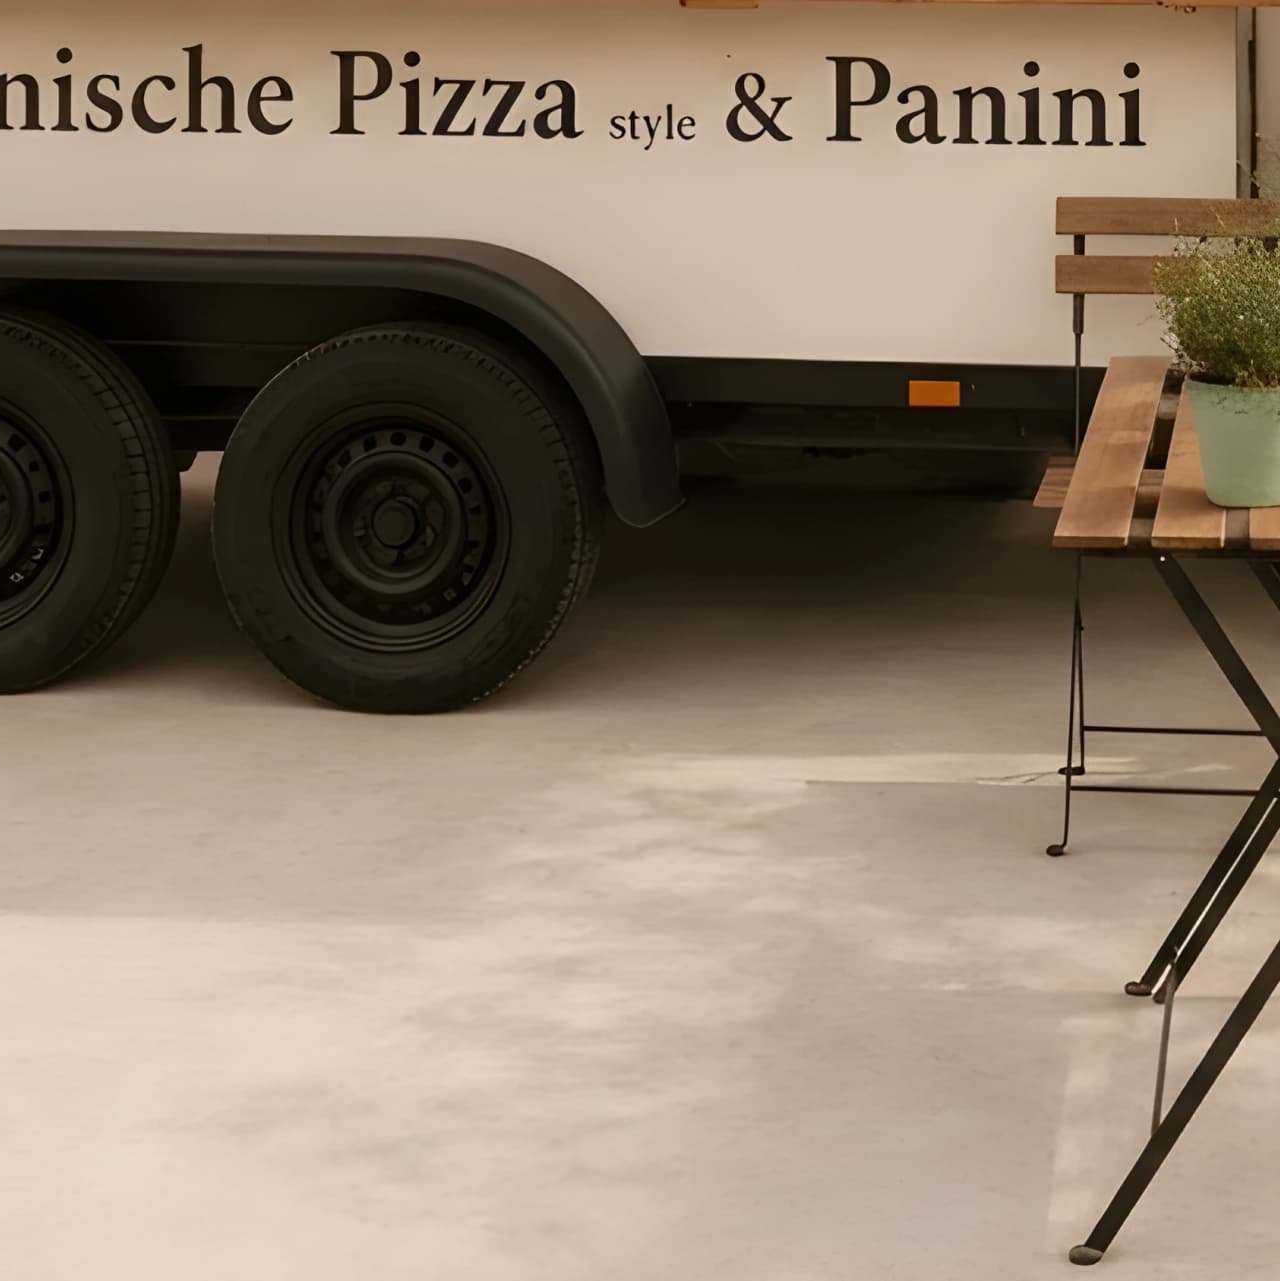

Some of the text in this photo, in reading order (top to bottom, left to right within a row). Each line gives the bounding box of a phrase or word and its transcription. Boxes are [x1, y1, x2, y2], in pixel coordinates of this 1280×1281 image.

[329, 50, 585, 141] Pizza
[608, 103, 697, 151] style
[725, 72, 793, 144] &
[826, 55, 1147, 146] Panini
